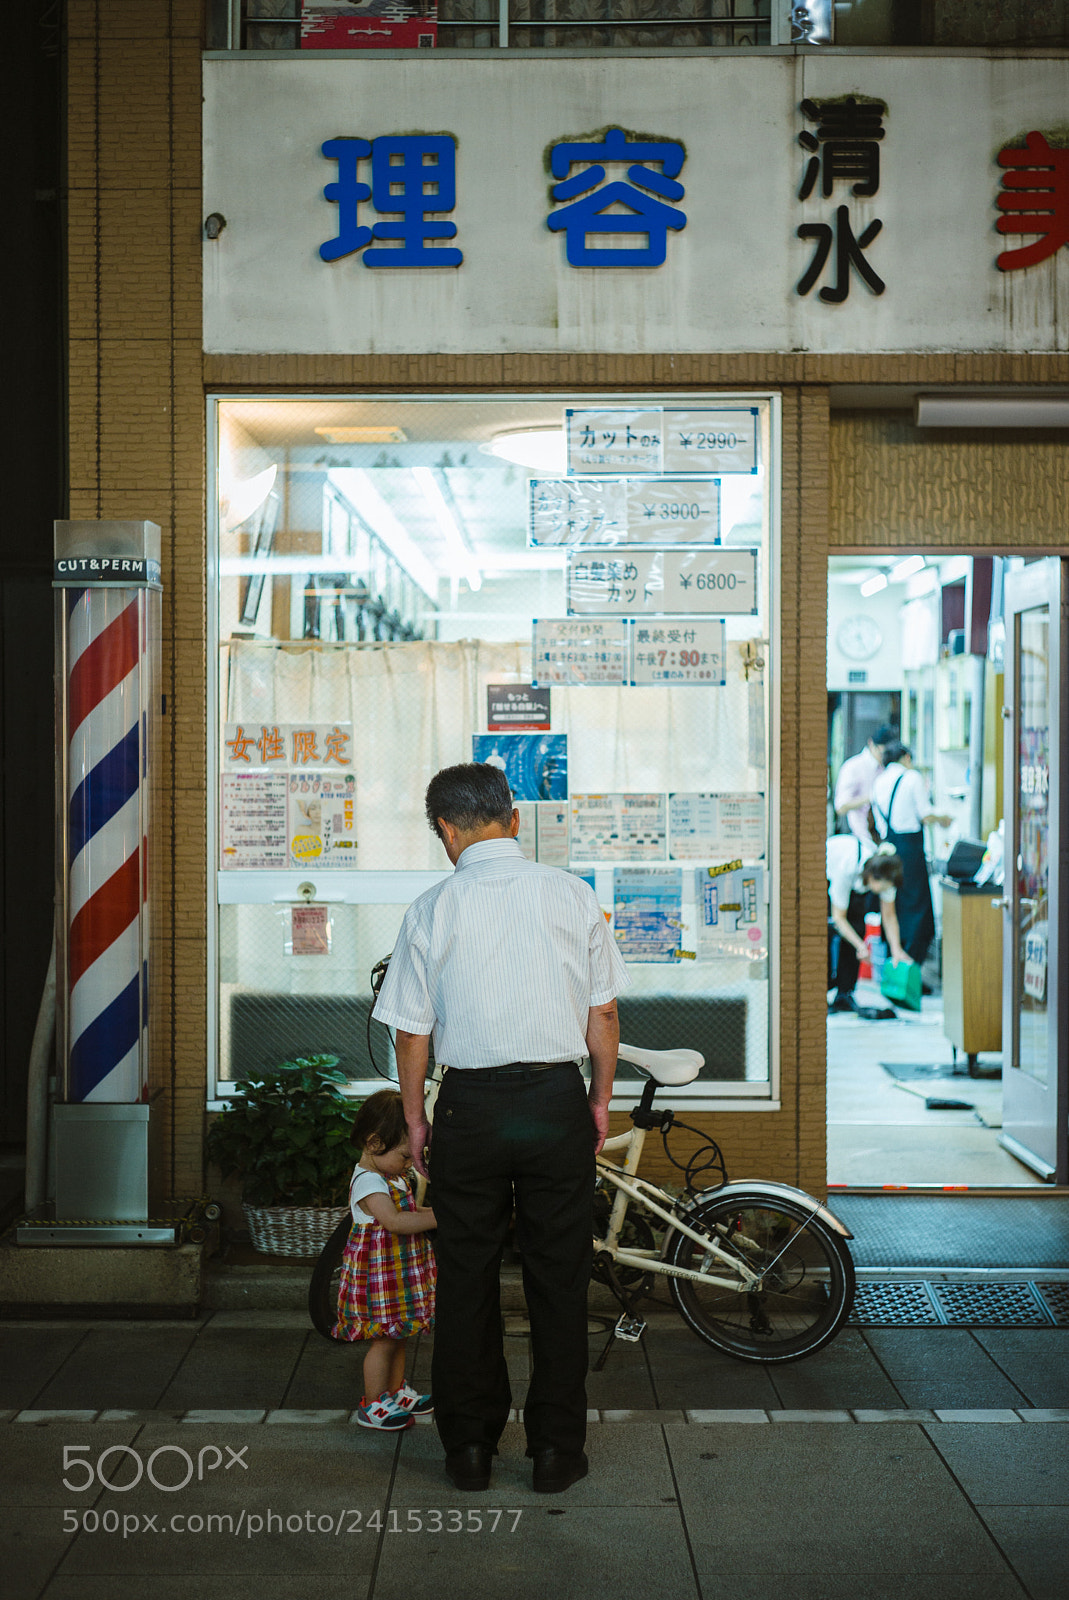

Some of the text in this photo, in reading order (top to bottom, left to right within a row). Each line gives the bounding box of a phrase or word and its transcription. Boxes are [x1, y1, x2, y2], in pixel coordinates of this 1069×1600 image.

[797, 98, 888, 304] 清水
[579, 425, 661, 449] カットのみ
[57, 558, 143, 573] CUT&PERM
[607, 585, 653, 603] カット
[637, 628, 697, 644] 最終受付
[225, 726, 352, 765] 女性限定
